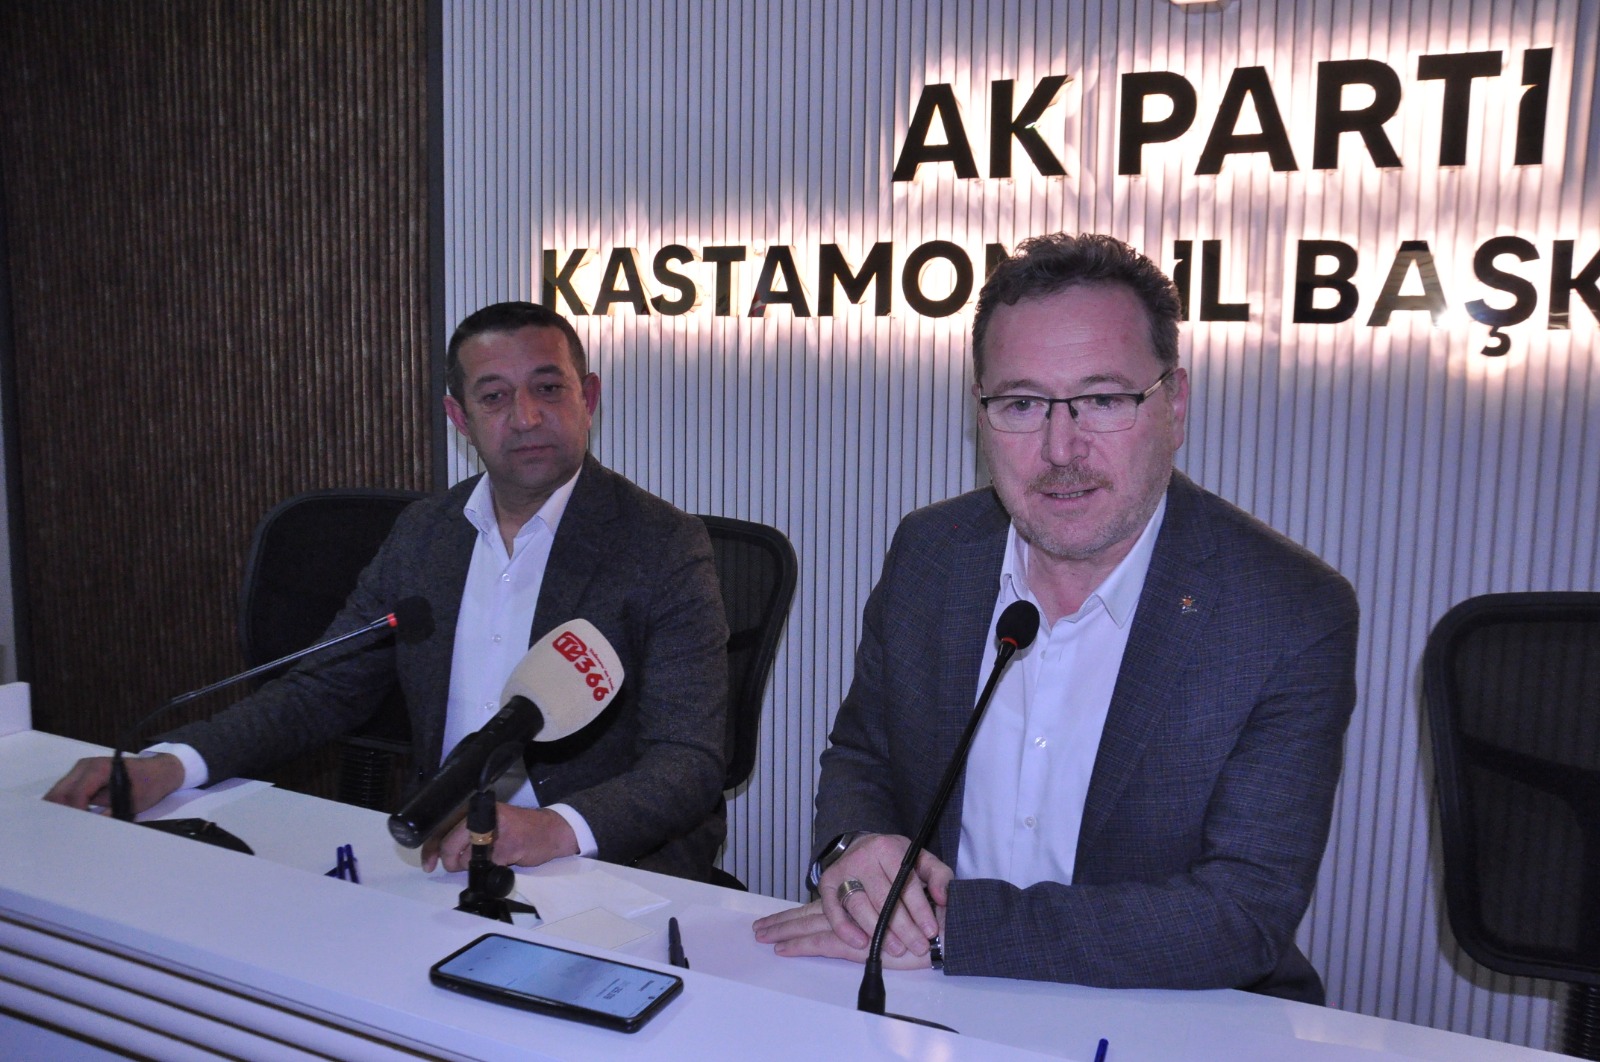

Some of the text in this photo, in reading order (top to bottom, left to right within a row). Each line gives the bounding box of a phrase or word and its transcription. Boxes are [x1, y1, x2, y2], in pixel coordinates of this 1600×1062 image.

[892, 48, 1553, 182] AK PARTİ
[543, 240, 1009, 318] KASTAMO
